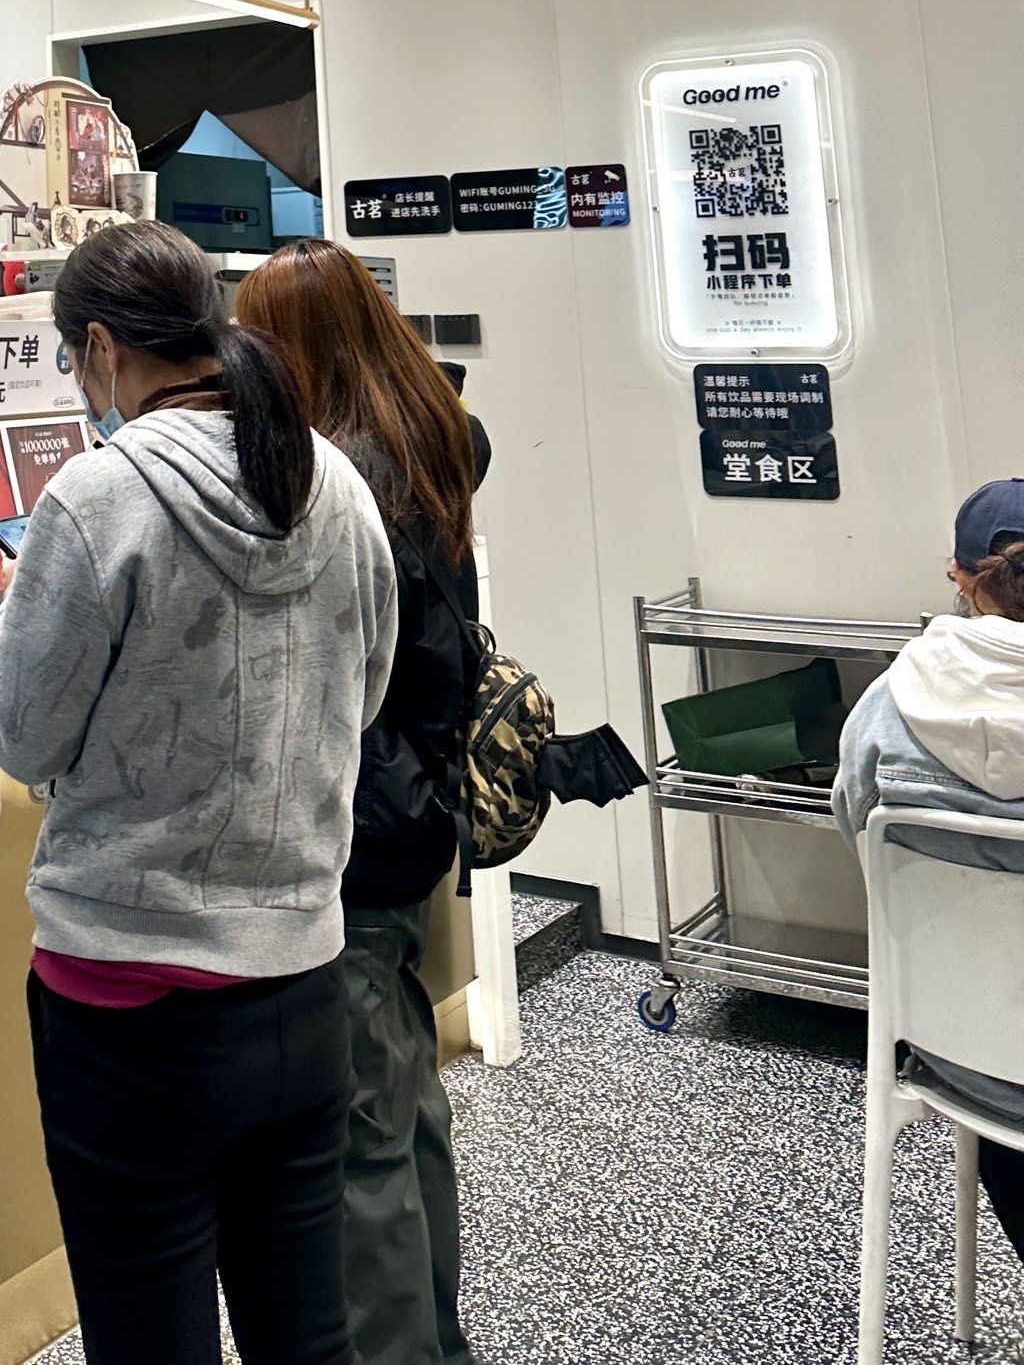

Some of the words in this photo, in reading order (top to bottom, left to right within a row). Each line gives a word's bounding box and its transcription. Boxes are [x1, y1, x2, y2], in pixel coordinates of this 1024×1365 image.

[682, 85, 740, 105] Good
[744, 83, 780, 101] me
[727, 167, 747, 179] 古茗
[570, 174, 590, 186] 古茗
[394, 191, 435, 203] 店长提醒
[570, 191, 625, 207] 内有监控
[350, 198, 383, 220] 古茗
[390, 205, 441, 218] 进店先洗手
[572, 208, 626, 218] MONITORING
[702, 232, 791, 272] 扫码
[706, 273, 792, 290] 小程序下单
[703, 375, 750, 387] 温馨提示
[799, 373, 818, 385] 古茗
[704, 391, 824, 404] 所有饮品需要现场调制
[706, 406, 789, 420] 请您耐心等待哦
[722, 439, 748, 448] Good
[749, 441, 767, 449] me
[723, 453, 818, 484] 堂食区
